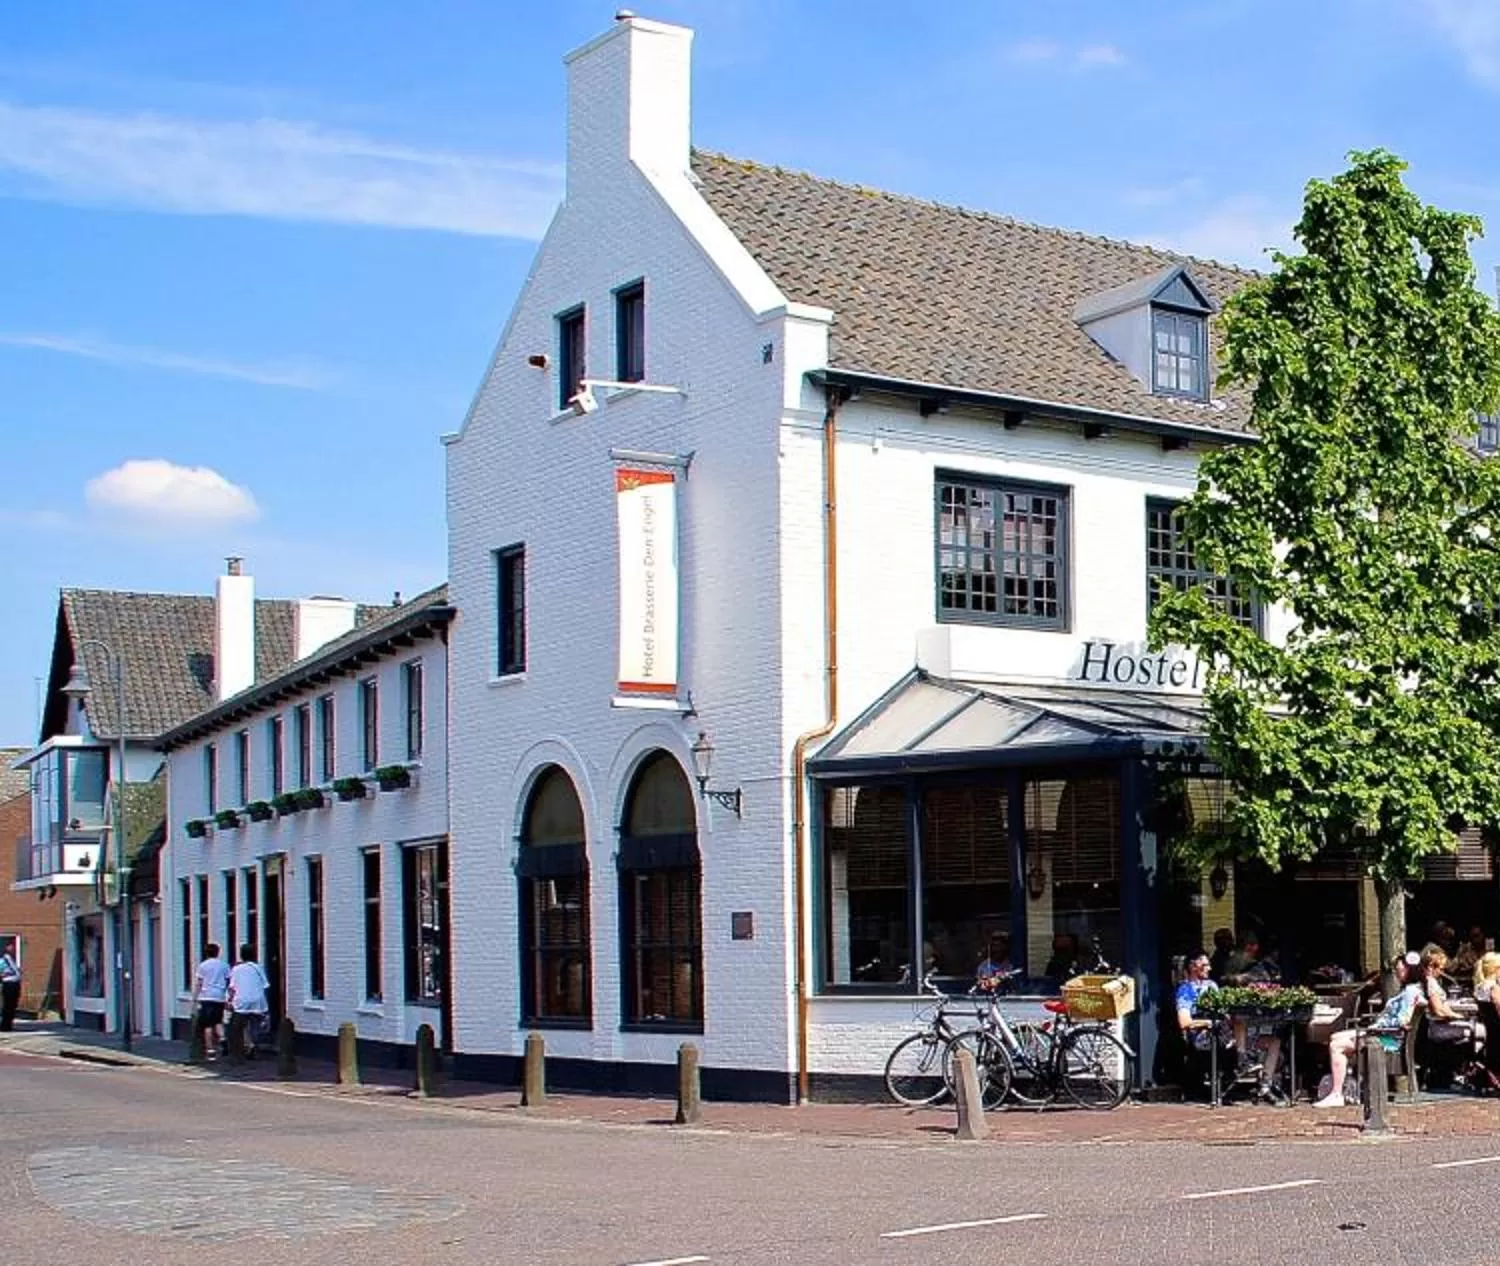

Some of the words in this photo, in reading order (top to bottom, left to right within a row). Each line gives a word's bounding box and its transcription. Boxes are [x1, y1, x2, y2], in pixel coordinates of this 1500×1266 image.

[642, 538, 655, 567] Den
[642, 570, 655, 634] Brasserie
[642, 637, 655, 678] Hotel
